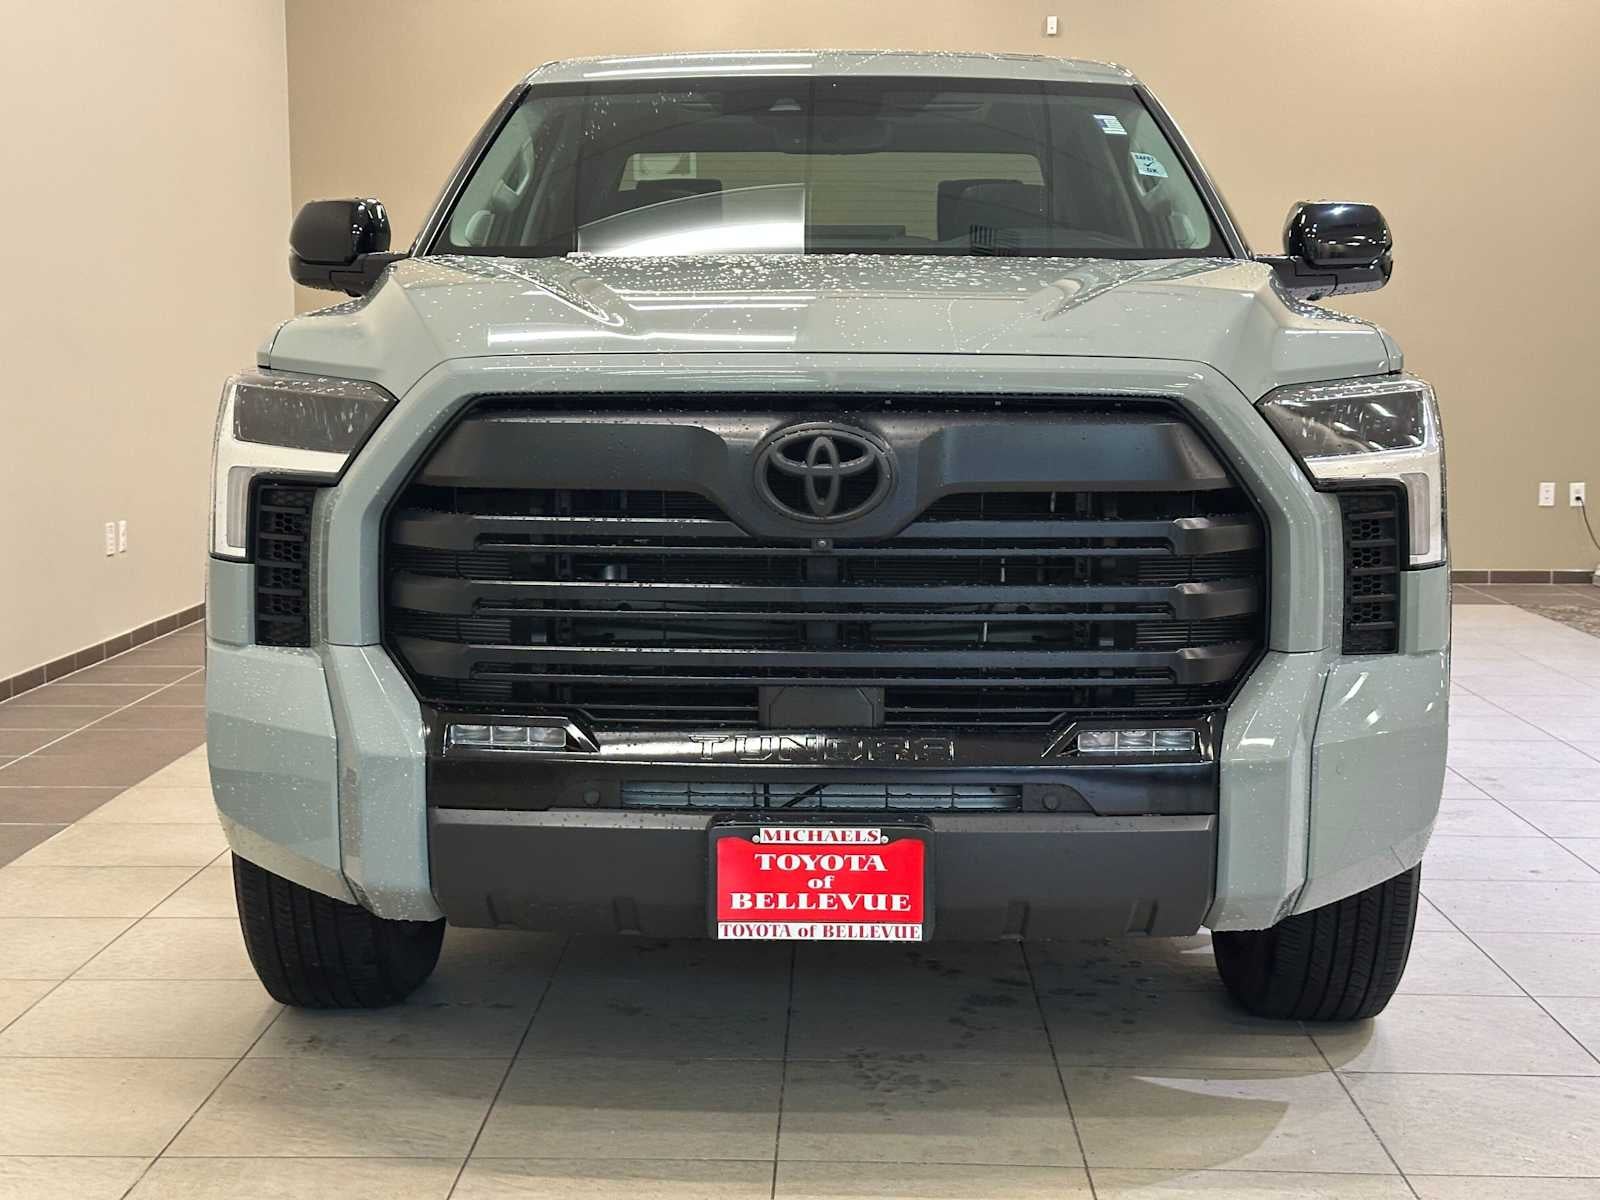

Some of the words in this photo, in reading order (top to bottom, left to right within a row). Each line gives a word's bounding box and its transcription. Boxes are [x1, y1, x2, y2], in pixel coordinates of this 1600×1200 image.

[688, 734, 955, 761] TUNDRA
[762, 829, 879, 843] MICHAELS
[754, 853, 888, 872] TOYOTA
[807, 875, 835, 889] of
[730, 892, 912, 912] BELLEVUE
[720, 923, 792, 938] TOYOTA
[797, 923, 817, 938] of
[823, 924, 922, 940] BELLEVUE
